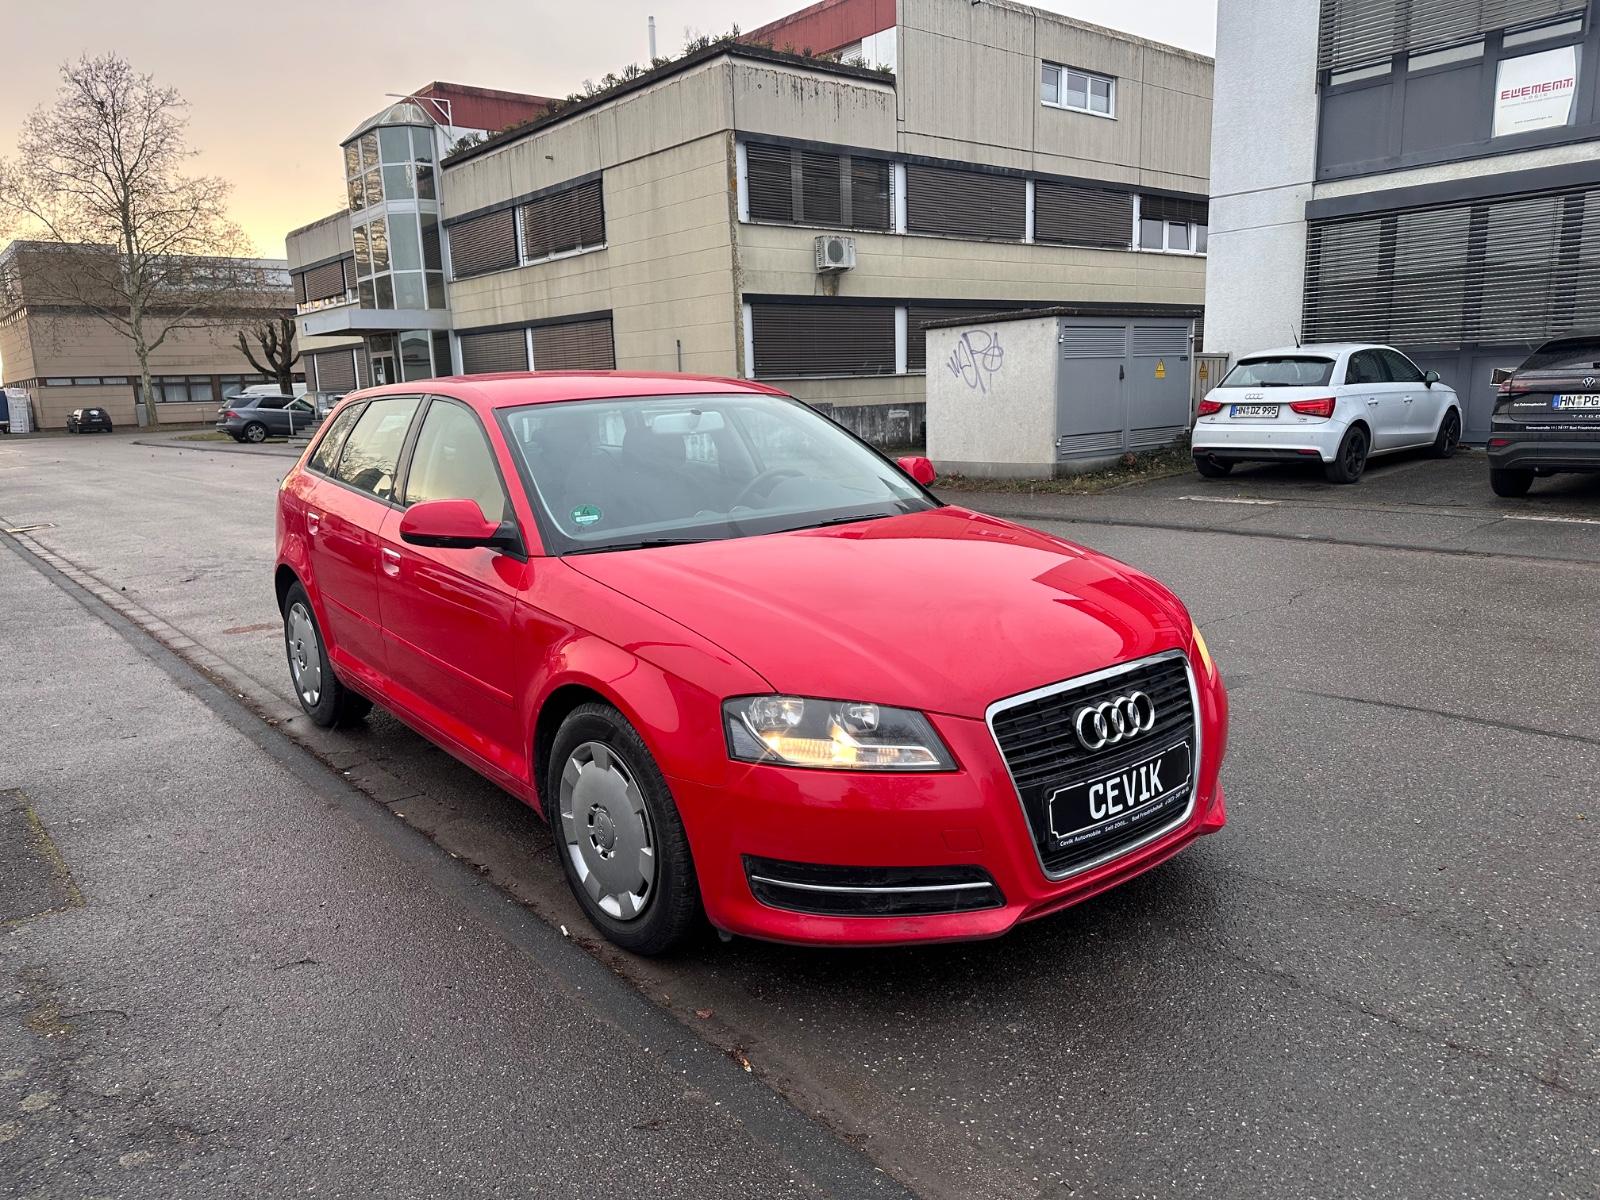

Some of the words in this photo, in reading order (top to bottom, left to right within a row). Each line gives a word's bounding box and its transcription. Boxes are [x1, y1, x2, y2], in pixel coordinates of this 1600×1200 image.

[1560, 396, 1576, 406] HN
[1236, 406, 1246, 414] HN
[1250, 406, 1260, 414] DZ
[1262, 406, 1278, 414] 995
[1089, 759, 1163, 820] CEVIK
[1060, 838, 1073, 847] Cevik
[1074, 829, 1101, 842] Automobile
